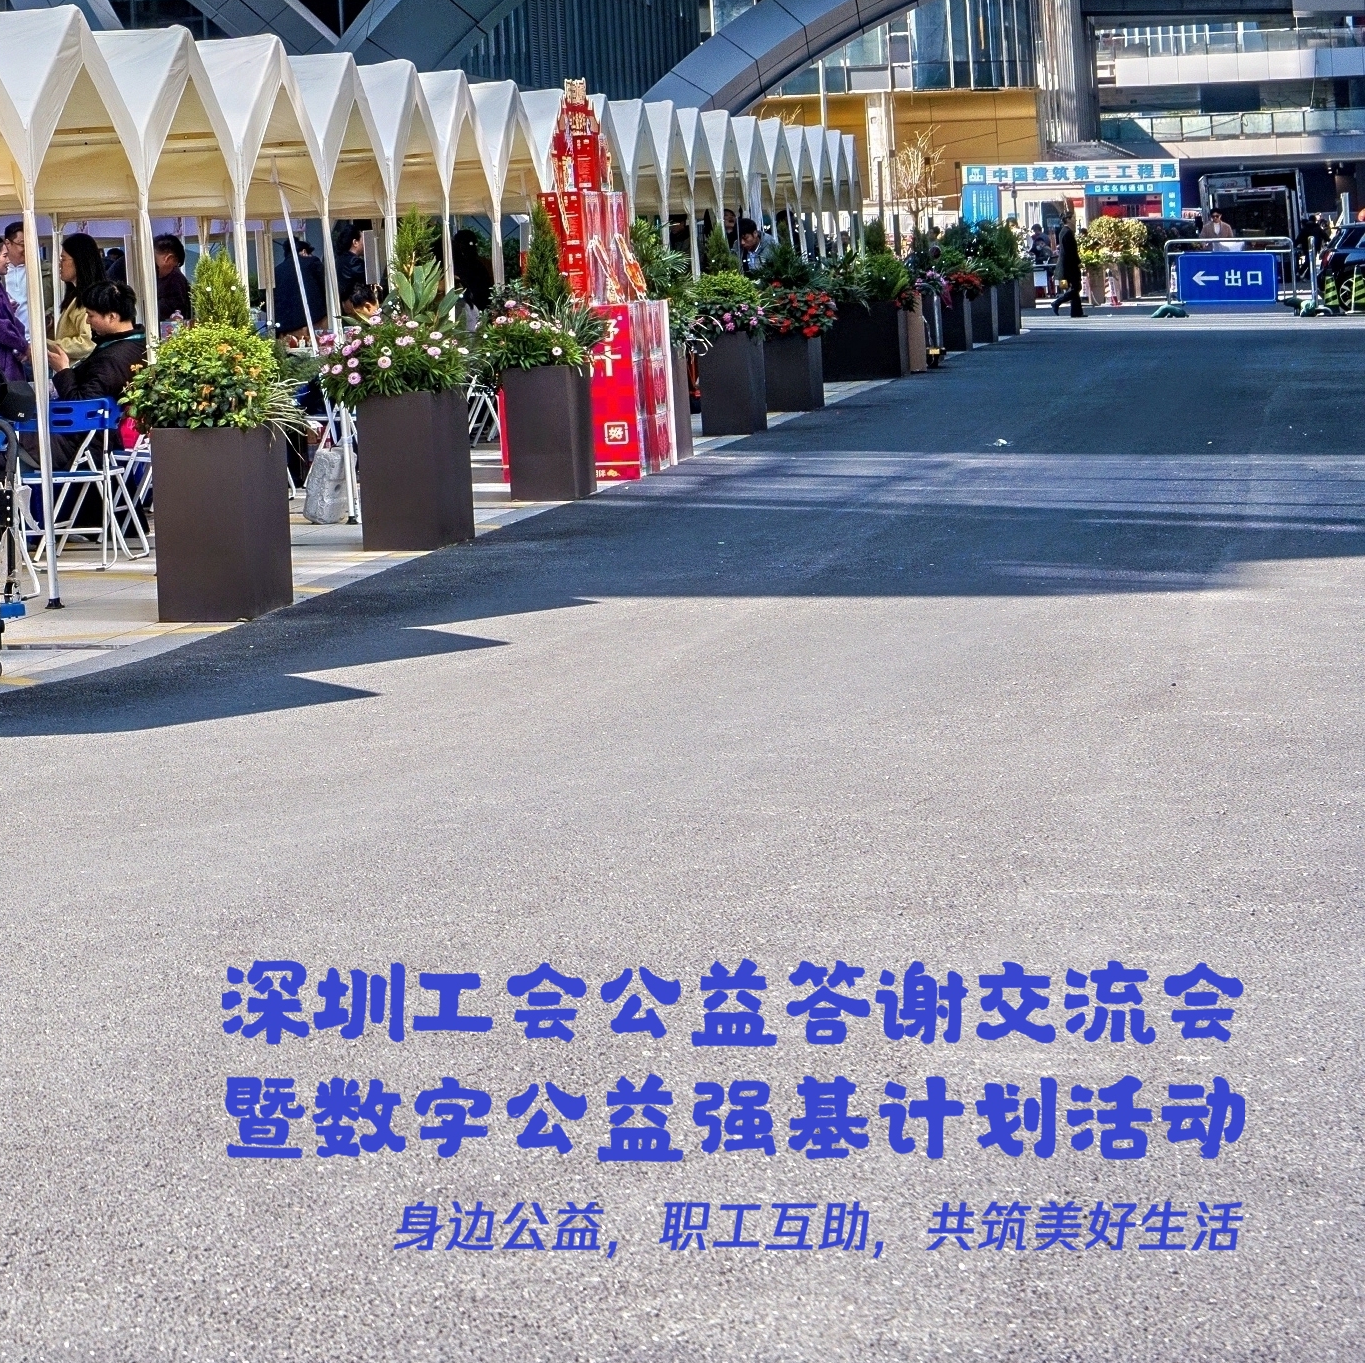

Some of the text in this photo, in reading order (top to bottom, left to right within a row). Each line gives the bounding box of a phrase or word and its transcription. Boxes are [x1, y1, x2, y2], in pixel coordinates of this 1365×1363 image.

[993, 164, 1176, 183] 中国建筑第二工程局
[1224, 269, 1263, 286] 出口
